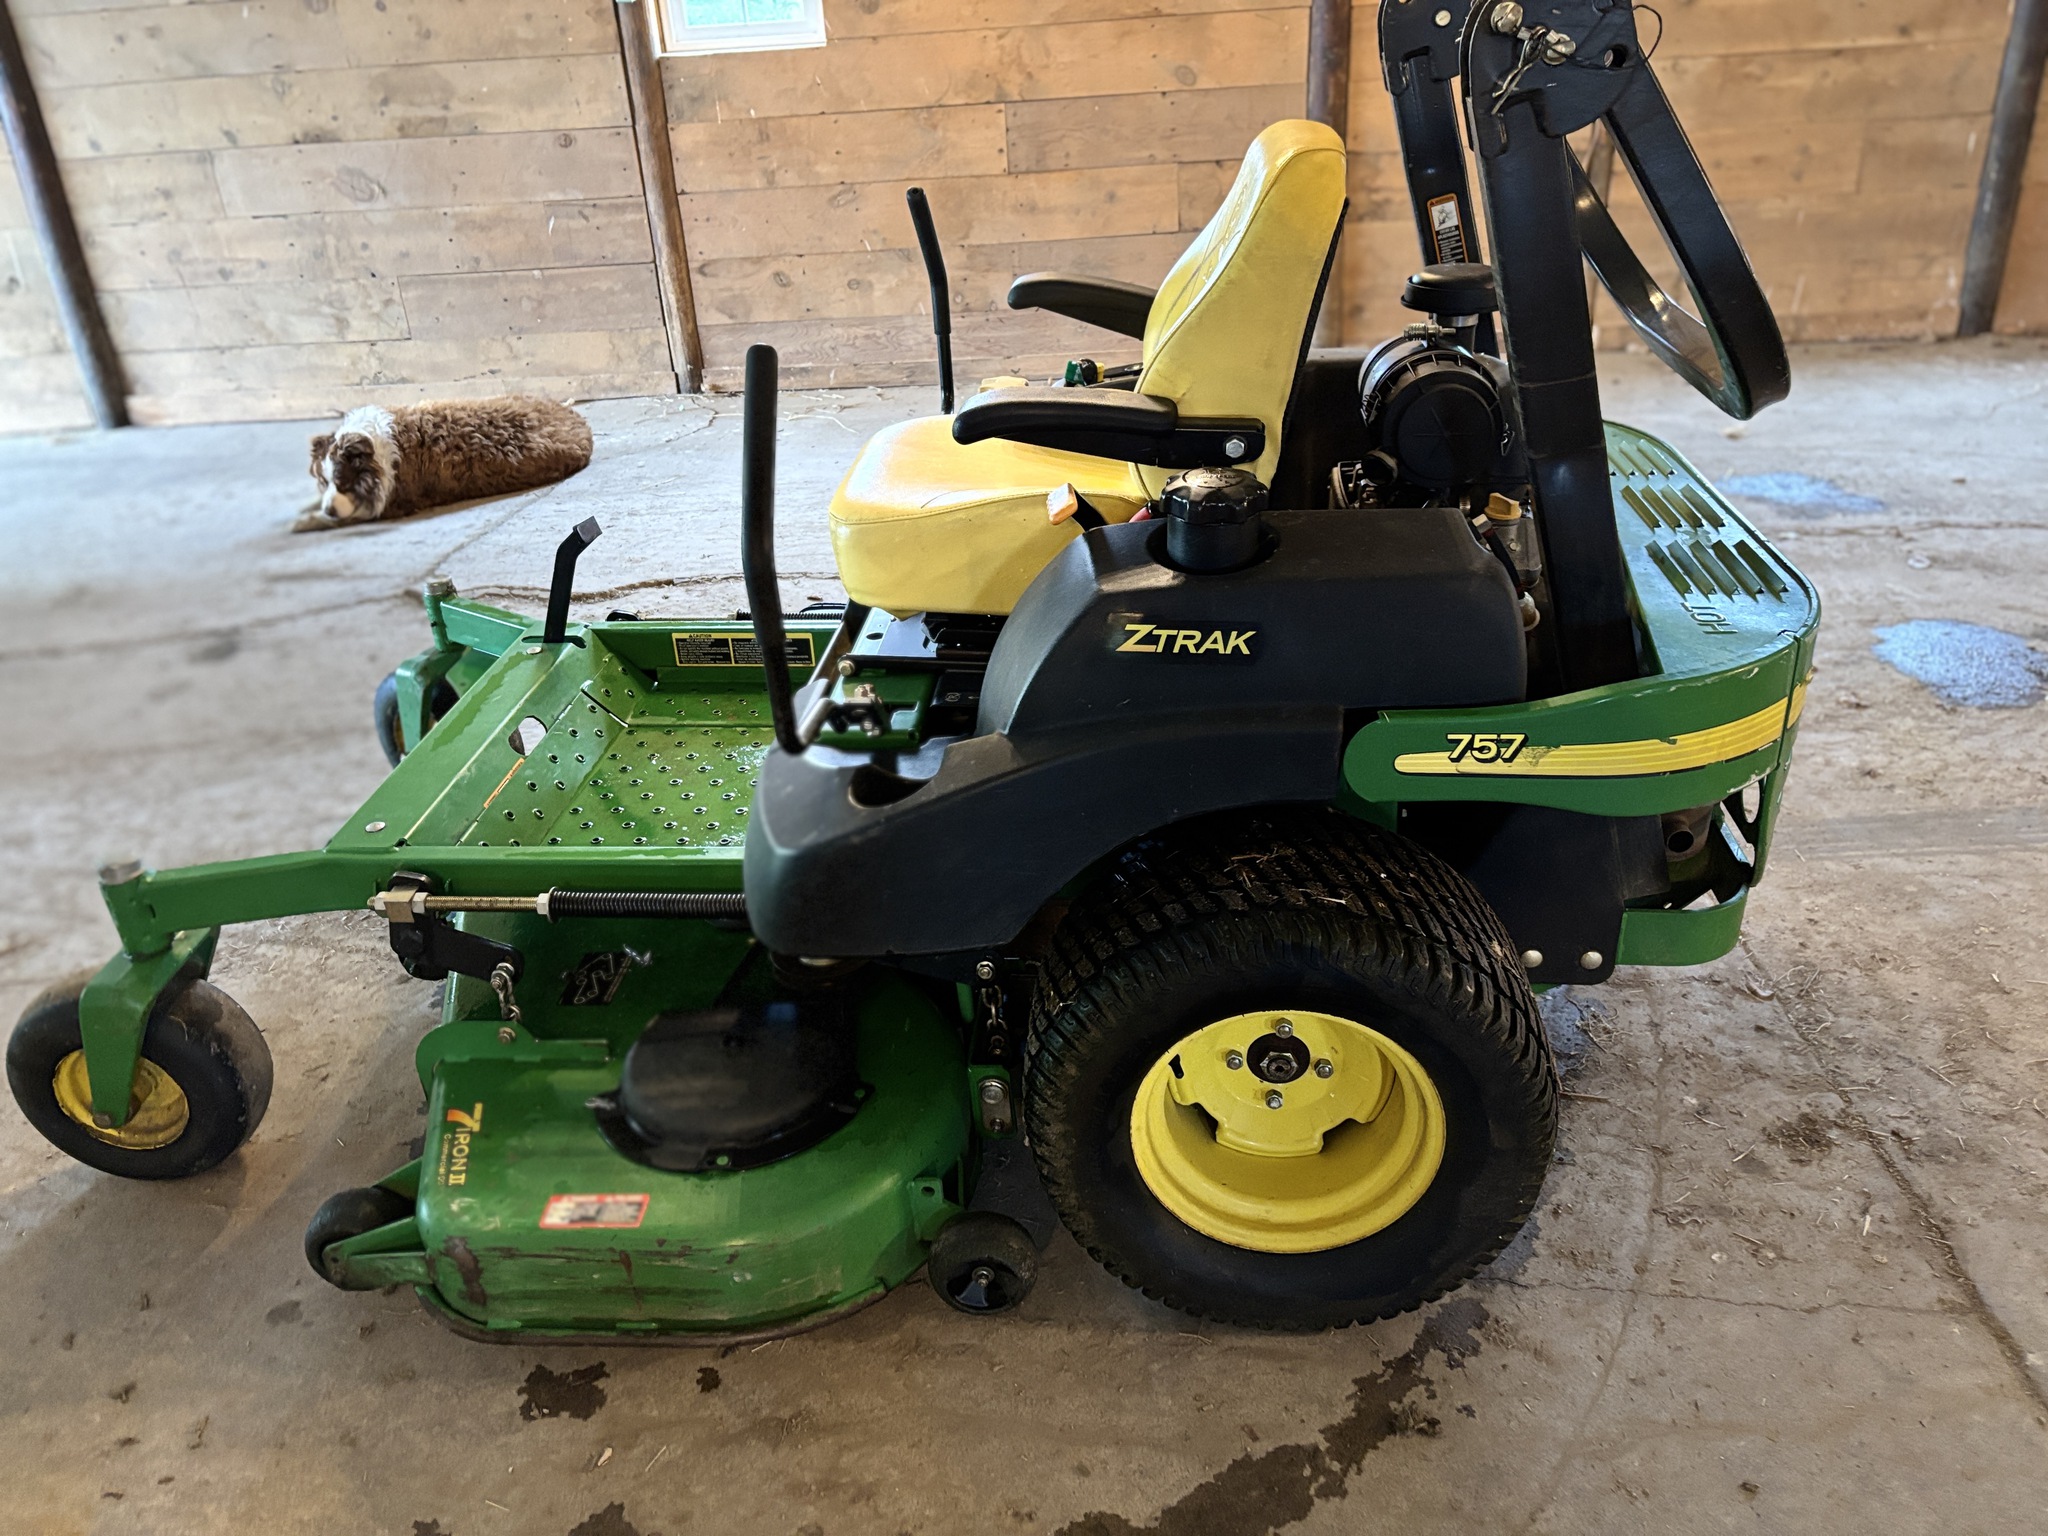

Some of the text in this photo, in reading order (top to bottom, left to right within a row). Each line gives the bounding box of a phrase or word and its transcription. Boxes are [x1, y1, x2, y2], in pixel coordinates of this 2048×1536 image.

[1680, 601, 1739, 635] HOT
[1115, 624, 1257, 655] ZTRAK
[1446, 732, 1530, 763] 757
